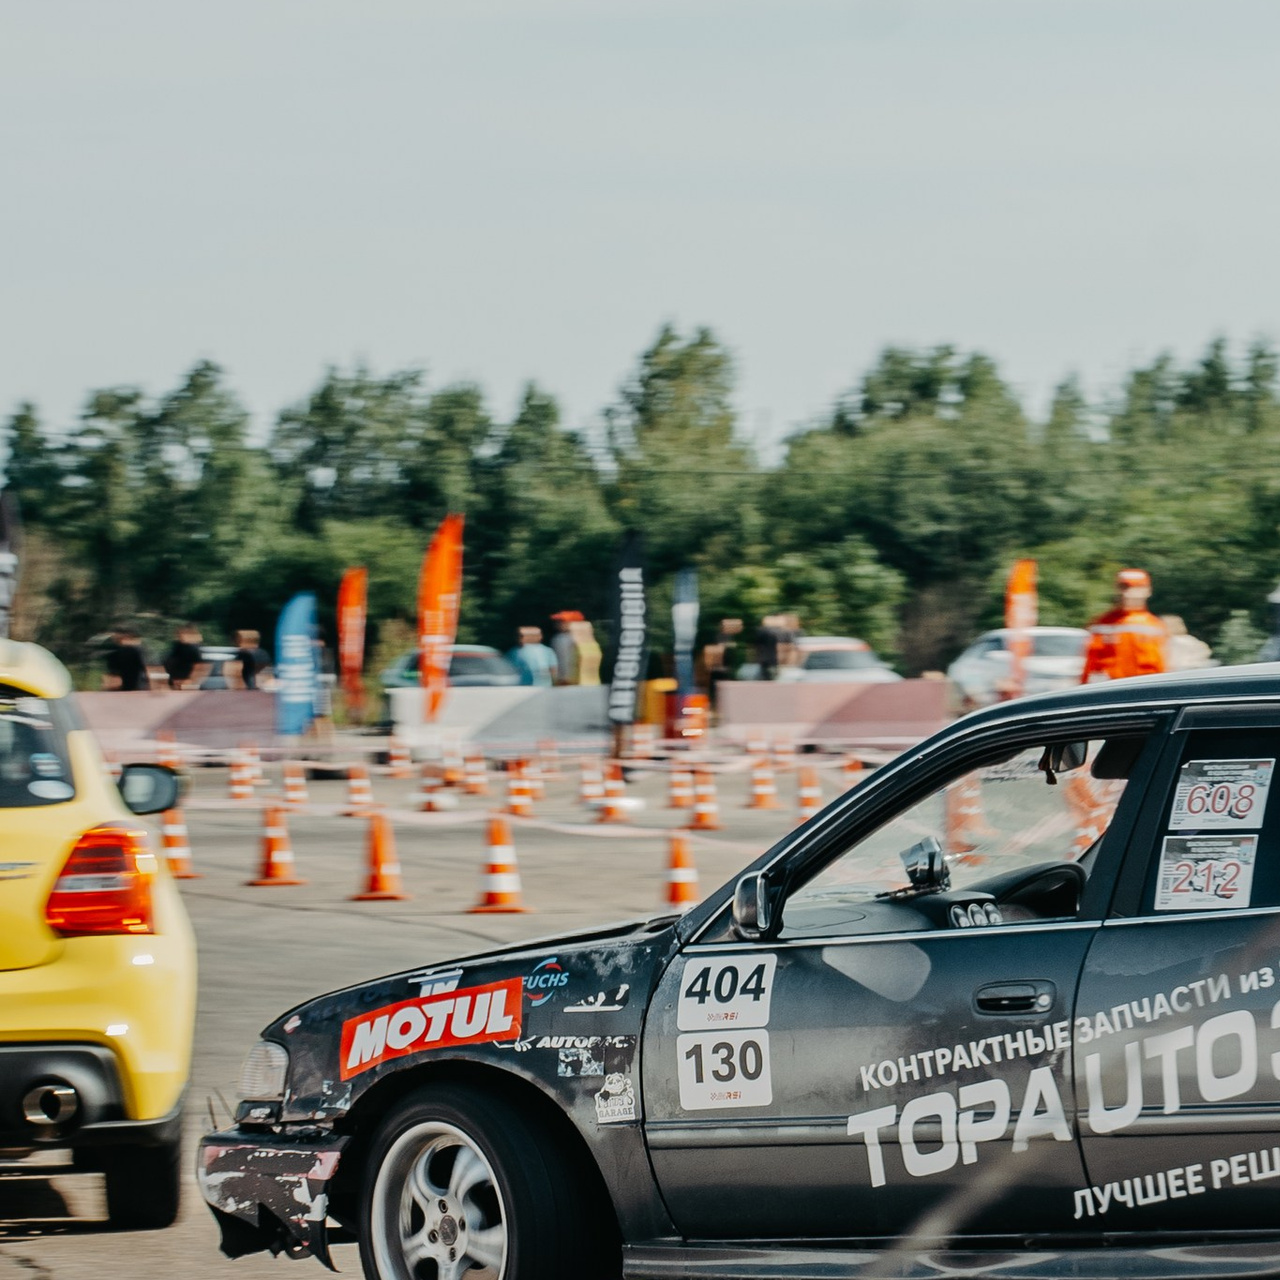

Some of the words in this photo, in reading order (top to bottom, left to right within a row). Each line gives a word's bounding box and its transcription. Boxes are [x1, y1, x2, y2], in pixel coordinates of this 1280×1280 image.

[1187, 784, 1256, 815] 608
[1171, 862, 1241, 893] 212
[685, 963, 766, 1004] 404
[346, 988, 514, 1070] MOTUL
[860, 1017, 1073, 1091] КОНТРАКТНЫЕ
[1077, 973, 1232, 1044] ЗАПЧАСТИ
[1240, 967, 1275, 994] из
[685, 1040, 763, 1084] 130
[599, 1107, 634, 1118] GARAGE
[1073, 1162, 1206, 1220] ЛУЧШЕЕ
